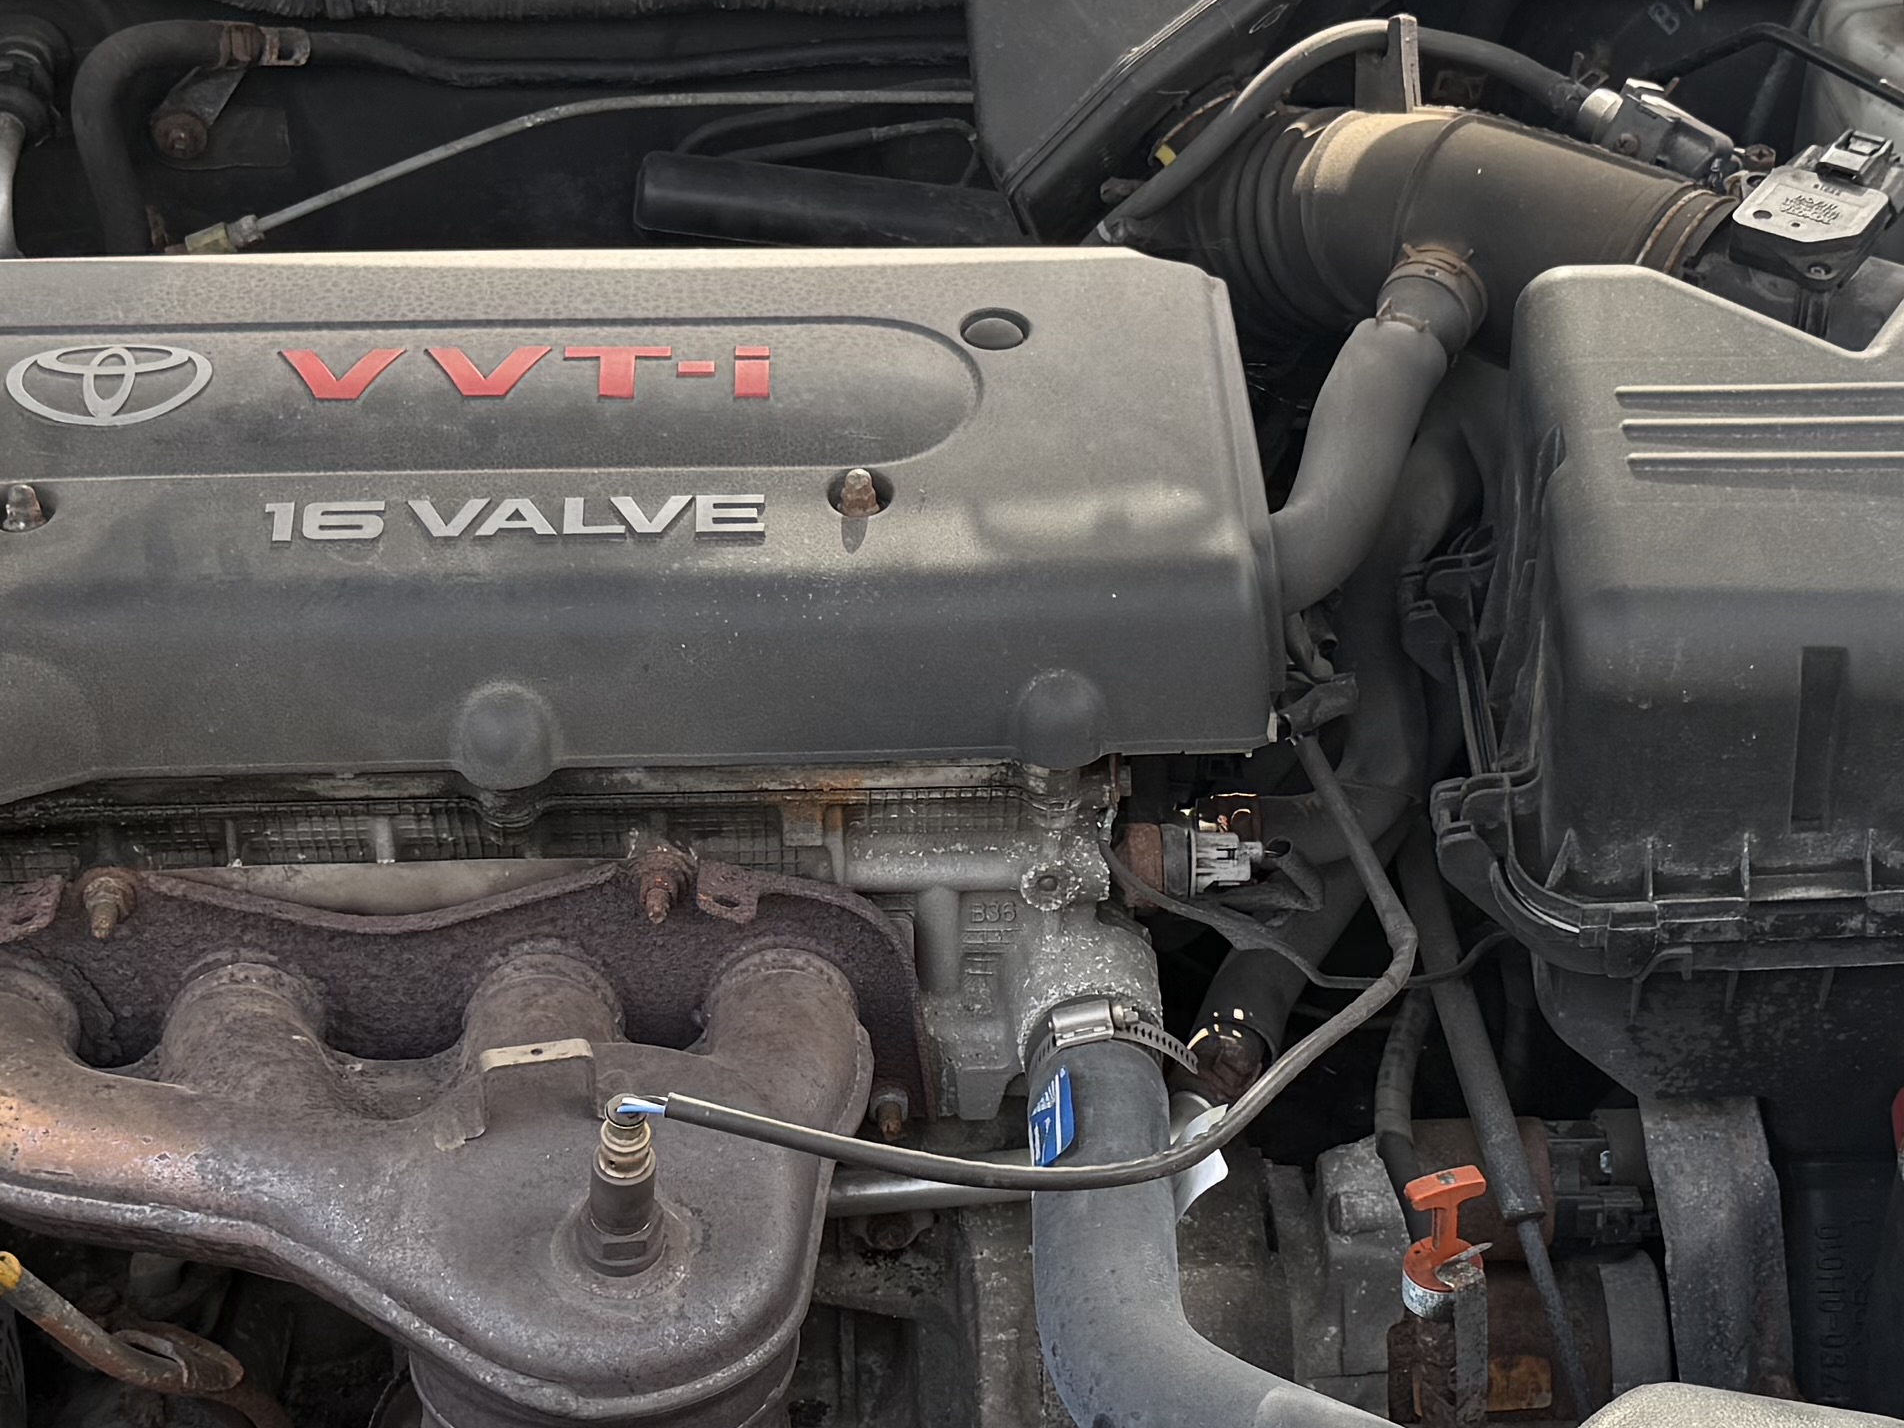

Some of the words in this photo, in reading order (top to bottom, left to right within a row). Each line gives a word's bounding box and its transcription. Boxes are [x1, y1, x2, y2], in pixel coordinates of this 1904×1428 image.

[279, 344, 770, 401] VVT-i
[265, 498, 386, 543] 16
[408, 493, 766, 539] VALVE
[970, 901, 1017, 923] B36
